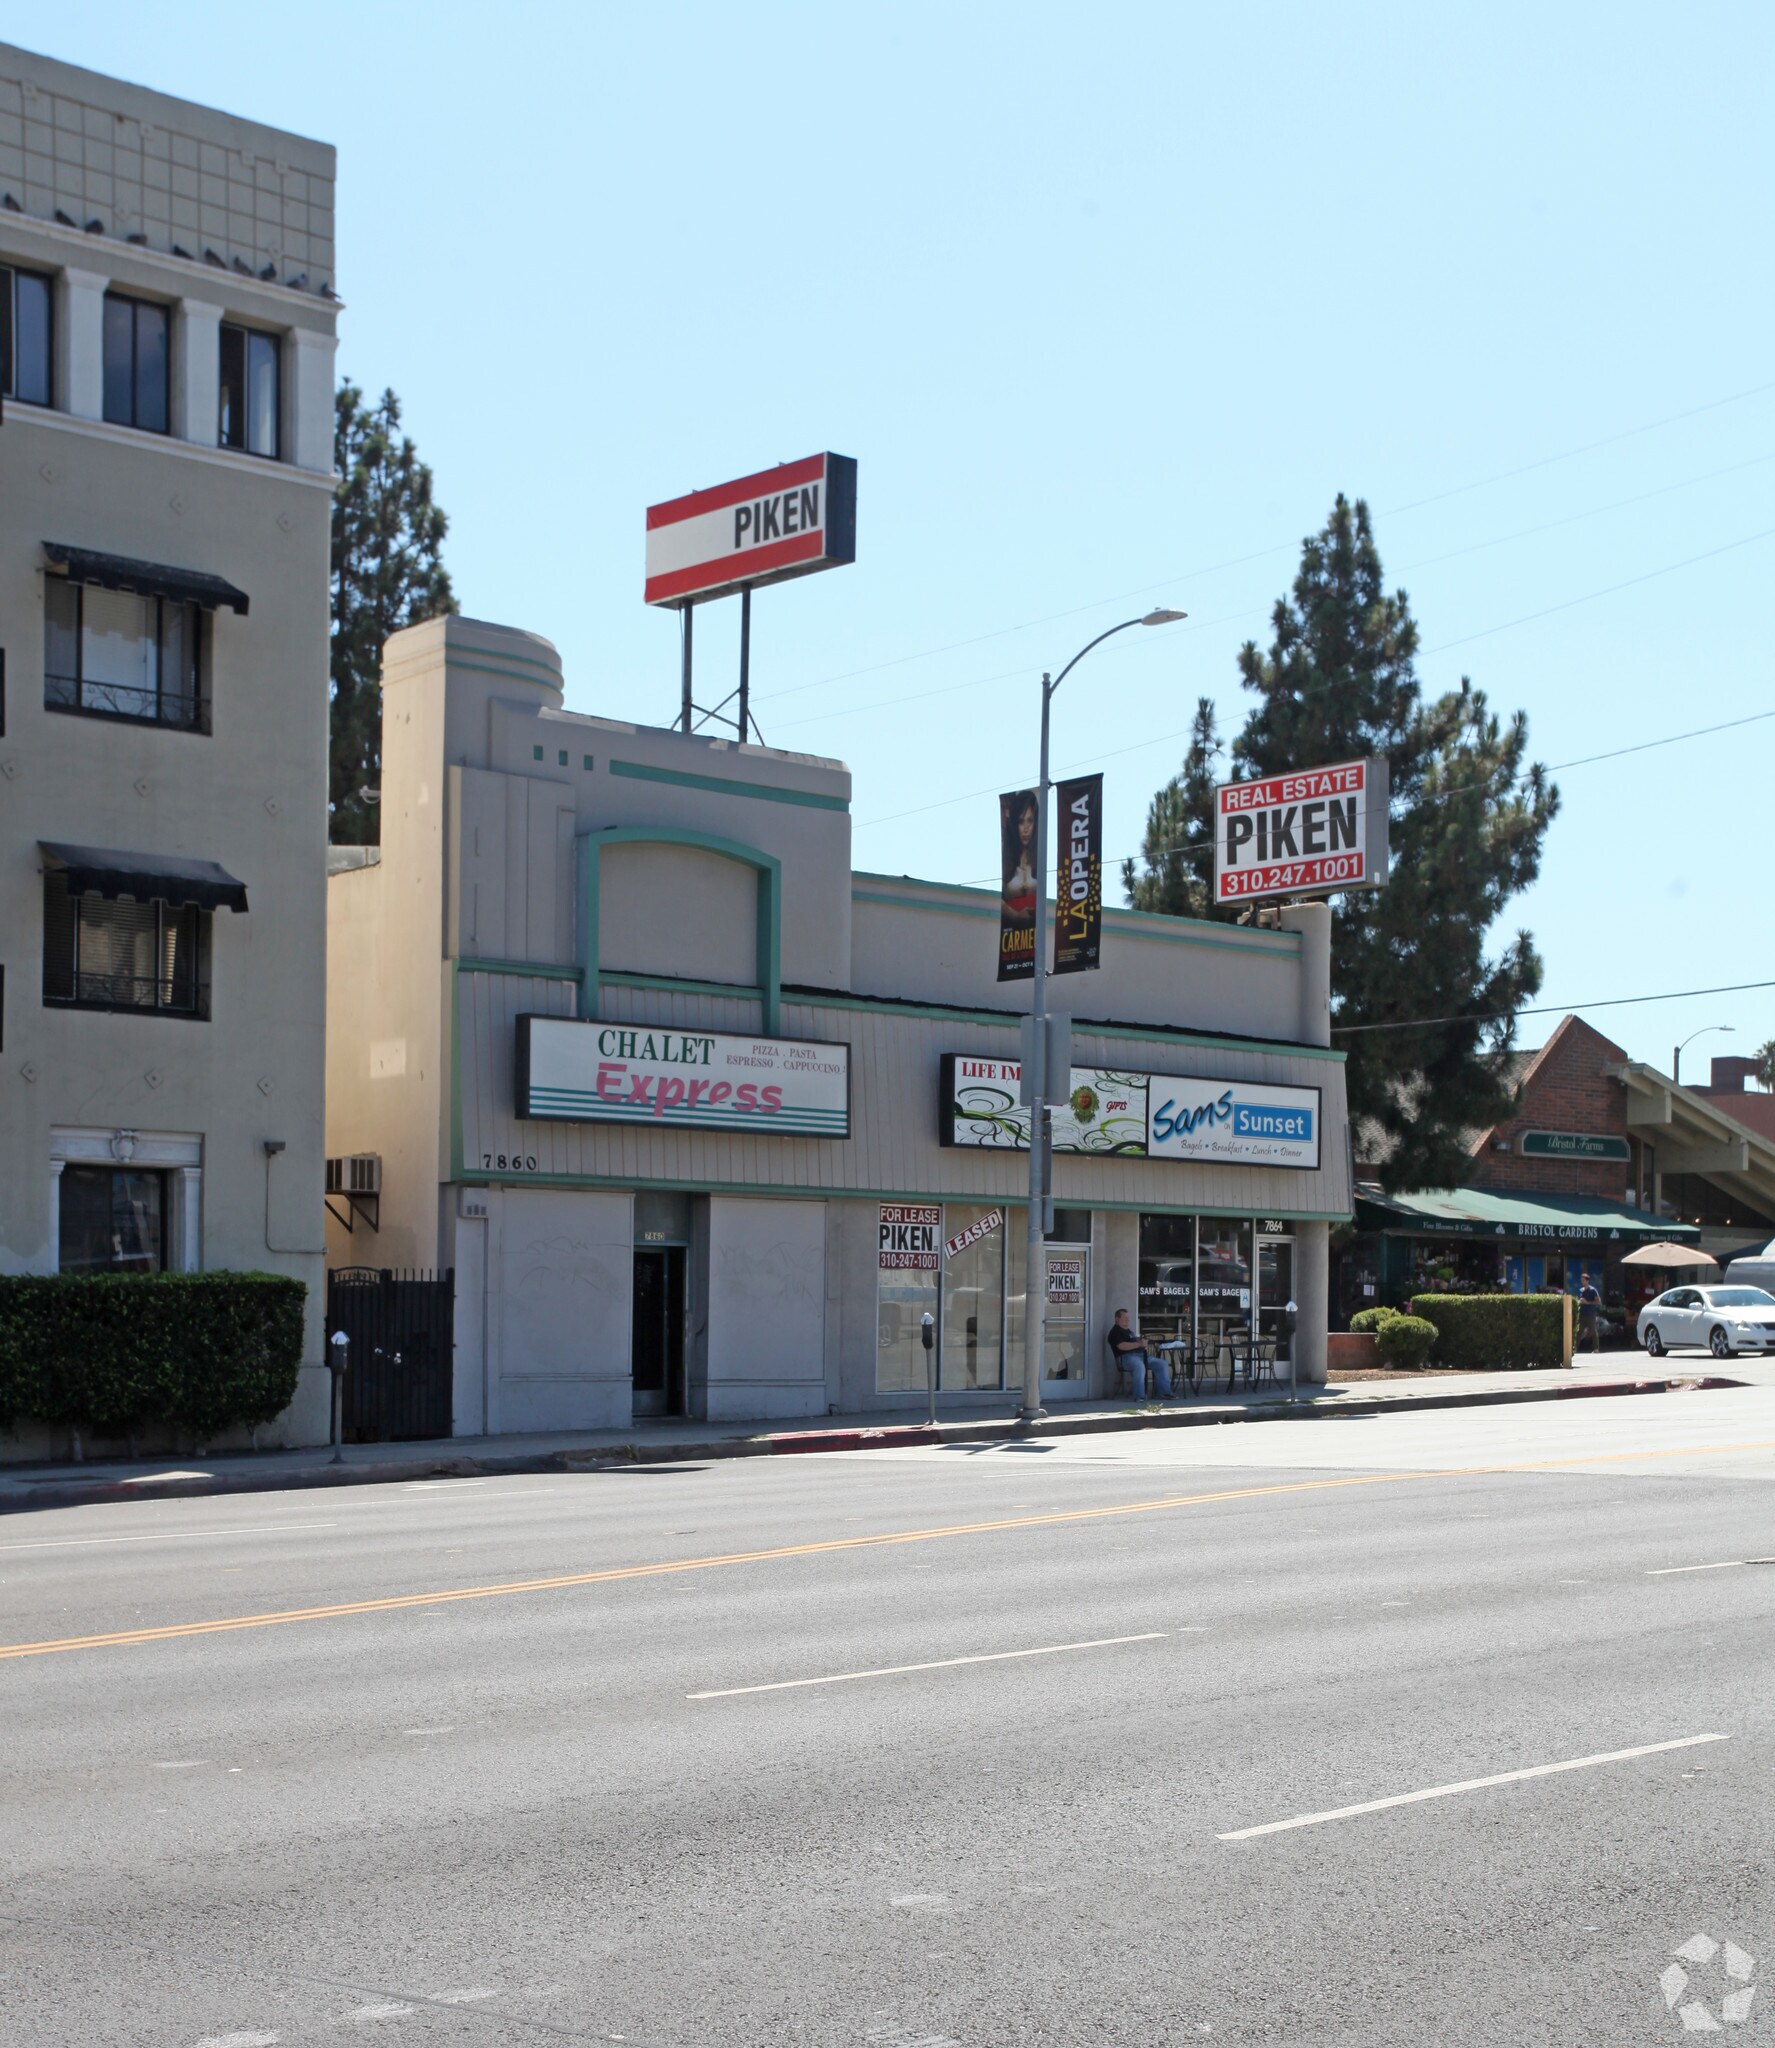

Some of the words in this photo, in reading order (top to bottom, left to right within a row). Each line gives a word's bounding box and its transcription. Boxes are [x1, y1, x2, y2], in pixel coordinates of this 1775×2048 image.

[735, 484, 819, 549] PIKEN
[1226, 785, 1277, 811] REAL
[1282, 769, 1358, 801] ESTATE
[1226, 796, 1357, 866] PIKEN
[1071, 794, 1090, 901] OPERA
[1226, 856, 1359, 894] 310.247.1001
[598, 1029, 716, 1066] CHALET
[752, 1045, 779, 1057] PIZZA
[789, 1048, 817, 1060] PASTA
[726, 1055, 774, 1069] ESPRESSO
[962, 1061, 997, 1079] LIFE
[596, 1062, 784, 1118] Express
[1239, 1110, 1304, 1135] Sunset
[1180, 1139, 1203, 1155] Bagels
[1211, 1142, 1243, 1155] Breakfast
[1251, 1145, 1272, 1155] Lunch
[1280, 1147, 1302, 1158] Dinner
[1548, 1135, 1575, 1149] Bristol
[1577, 1137, 1604, 1151] Farms
[483, 1154, 537, 1171] 7860
[880, 1208, 902, 1222] FOR
[904, 1209, 938, 1223] LEASE
[945, 1213, 1000, 1256] LEASED
[1265, 1221, 1283, 1232] 7864
[1518, 1223, 1555, 1237] BRISTOL
[1559, 1225, 1598, 1239] GARDENS
[879, 1224, 933, 1251] PIKEN
[880, 1253, 937, 1268] 310-247-1001
[1050, 1263, 1061, 1272] FOR
[1062, 1263, 1079, 1272] LEASE
[1049, 1275, 1076, 1290] PIKEN
[1140, 1287, 1161, 1296] SAM'S
[1163, 1287, 1190, 1296] BAGELS
[1199, 1288, 1219, 1297] SAM'S
[1222, 1288, 1240, 1297] BAGE
